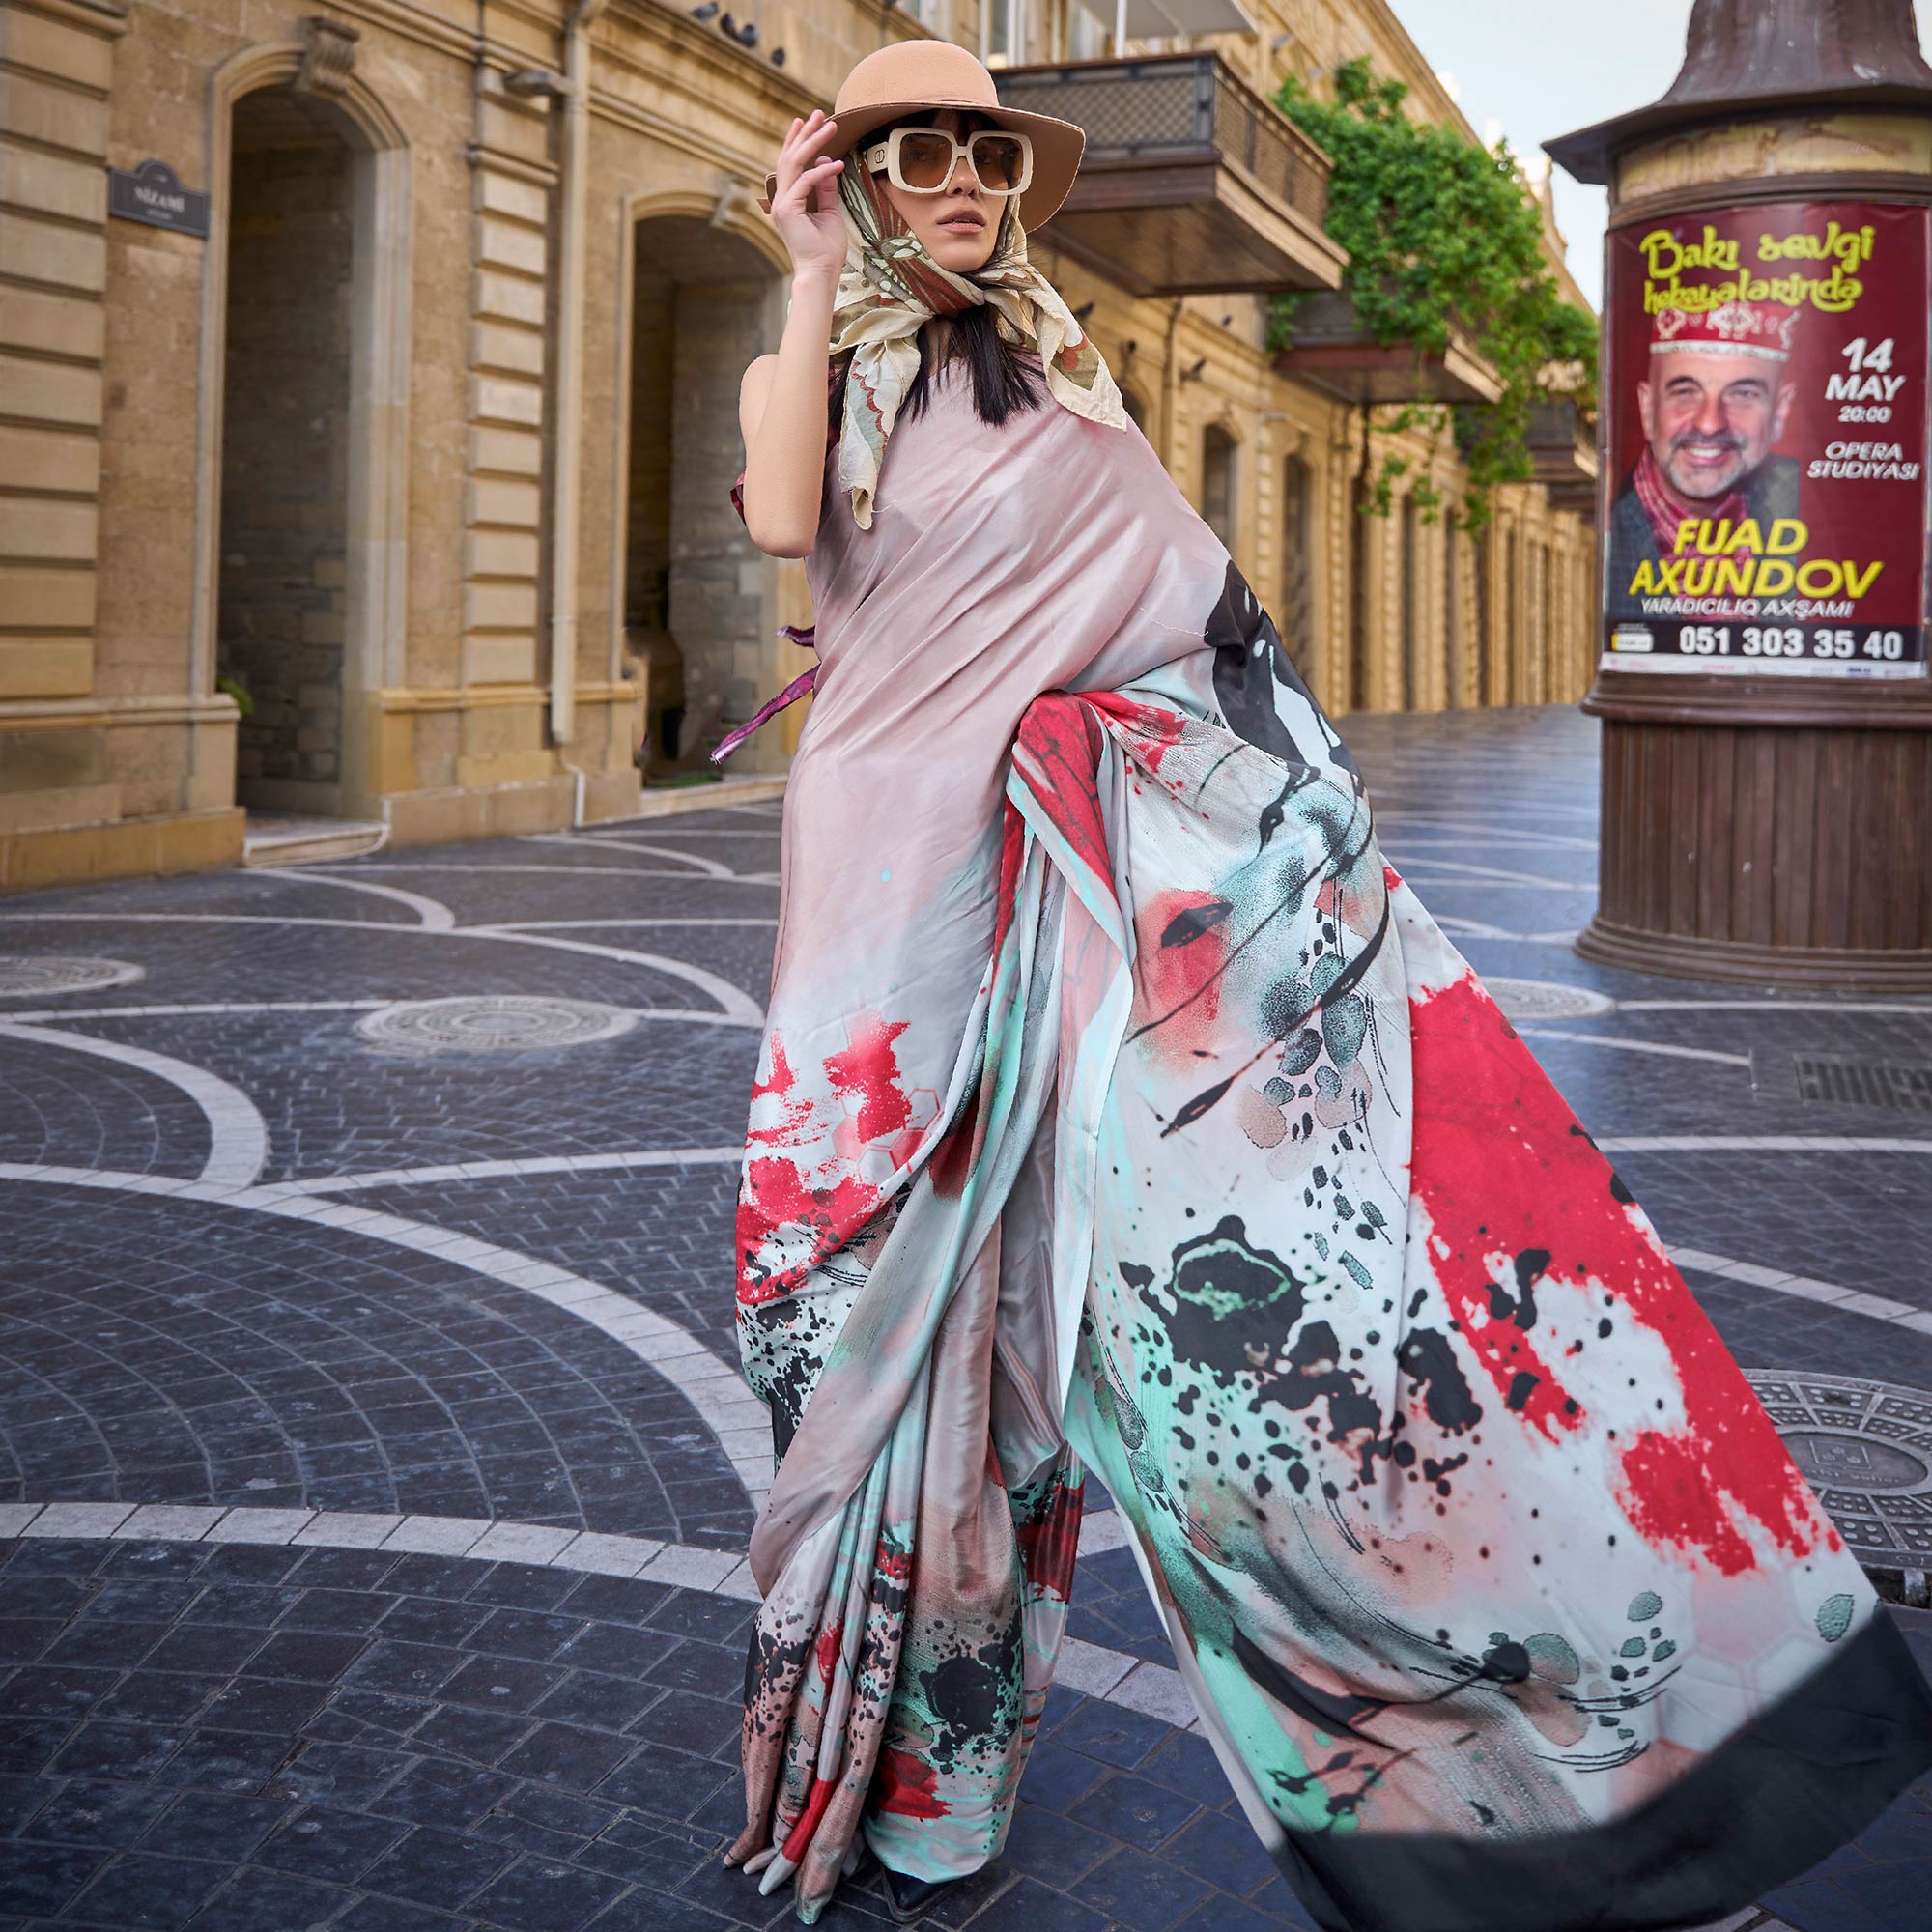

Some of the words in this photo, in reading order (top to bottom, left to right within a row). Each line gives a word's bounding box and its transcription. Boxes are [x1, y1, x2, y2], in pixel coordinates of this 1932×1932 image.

[1639, 225, 1740, 279] Bakı
[1757, 221, 1875, 273] sevgi
[1841, 338, 1894, 373] 14
[1825, 374, 1906, 401] MAY
[1838, 405, 1891, 423] 20:00
[1825, 441, 1903, 462] OPERA
[1673, 518, 1808, 555] FUAD
[1629, 558, 1885, 599] AXUNDOV
[1642, 597, 1760, 617] YARADICILIQ
[1761, 599, 1855, 621] AXŞAMI
[1679, 625, 1731, 655] 051
[1742, 627, 1804, 657] 303
[1813, 629, 1856, 659] 35
[1862, 630, 1903, 660] 40
